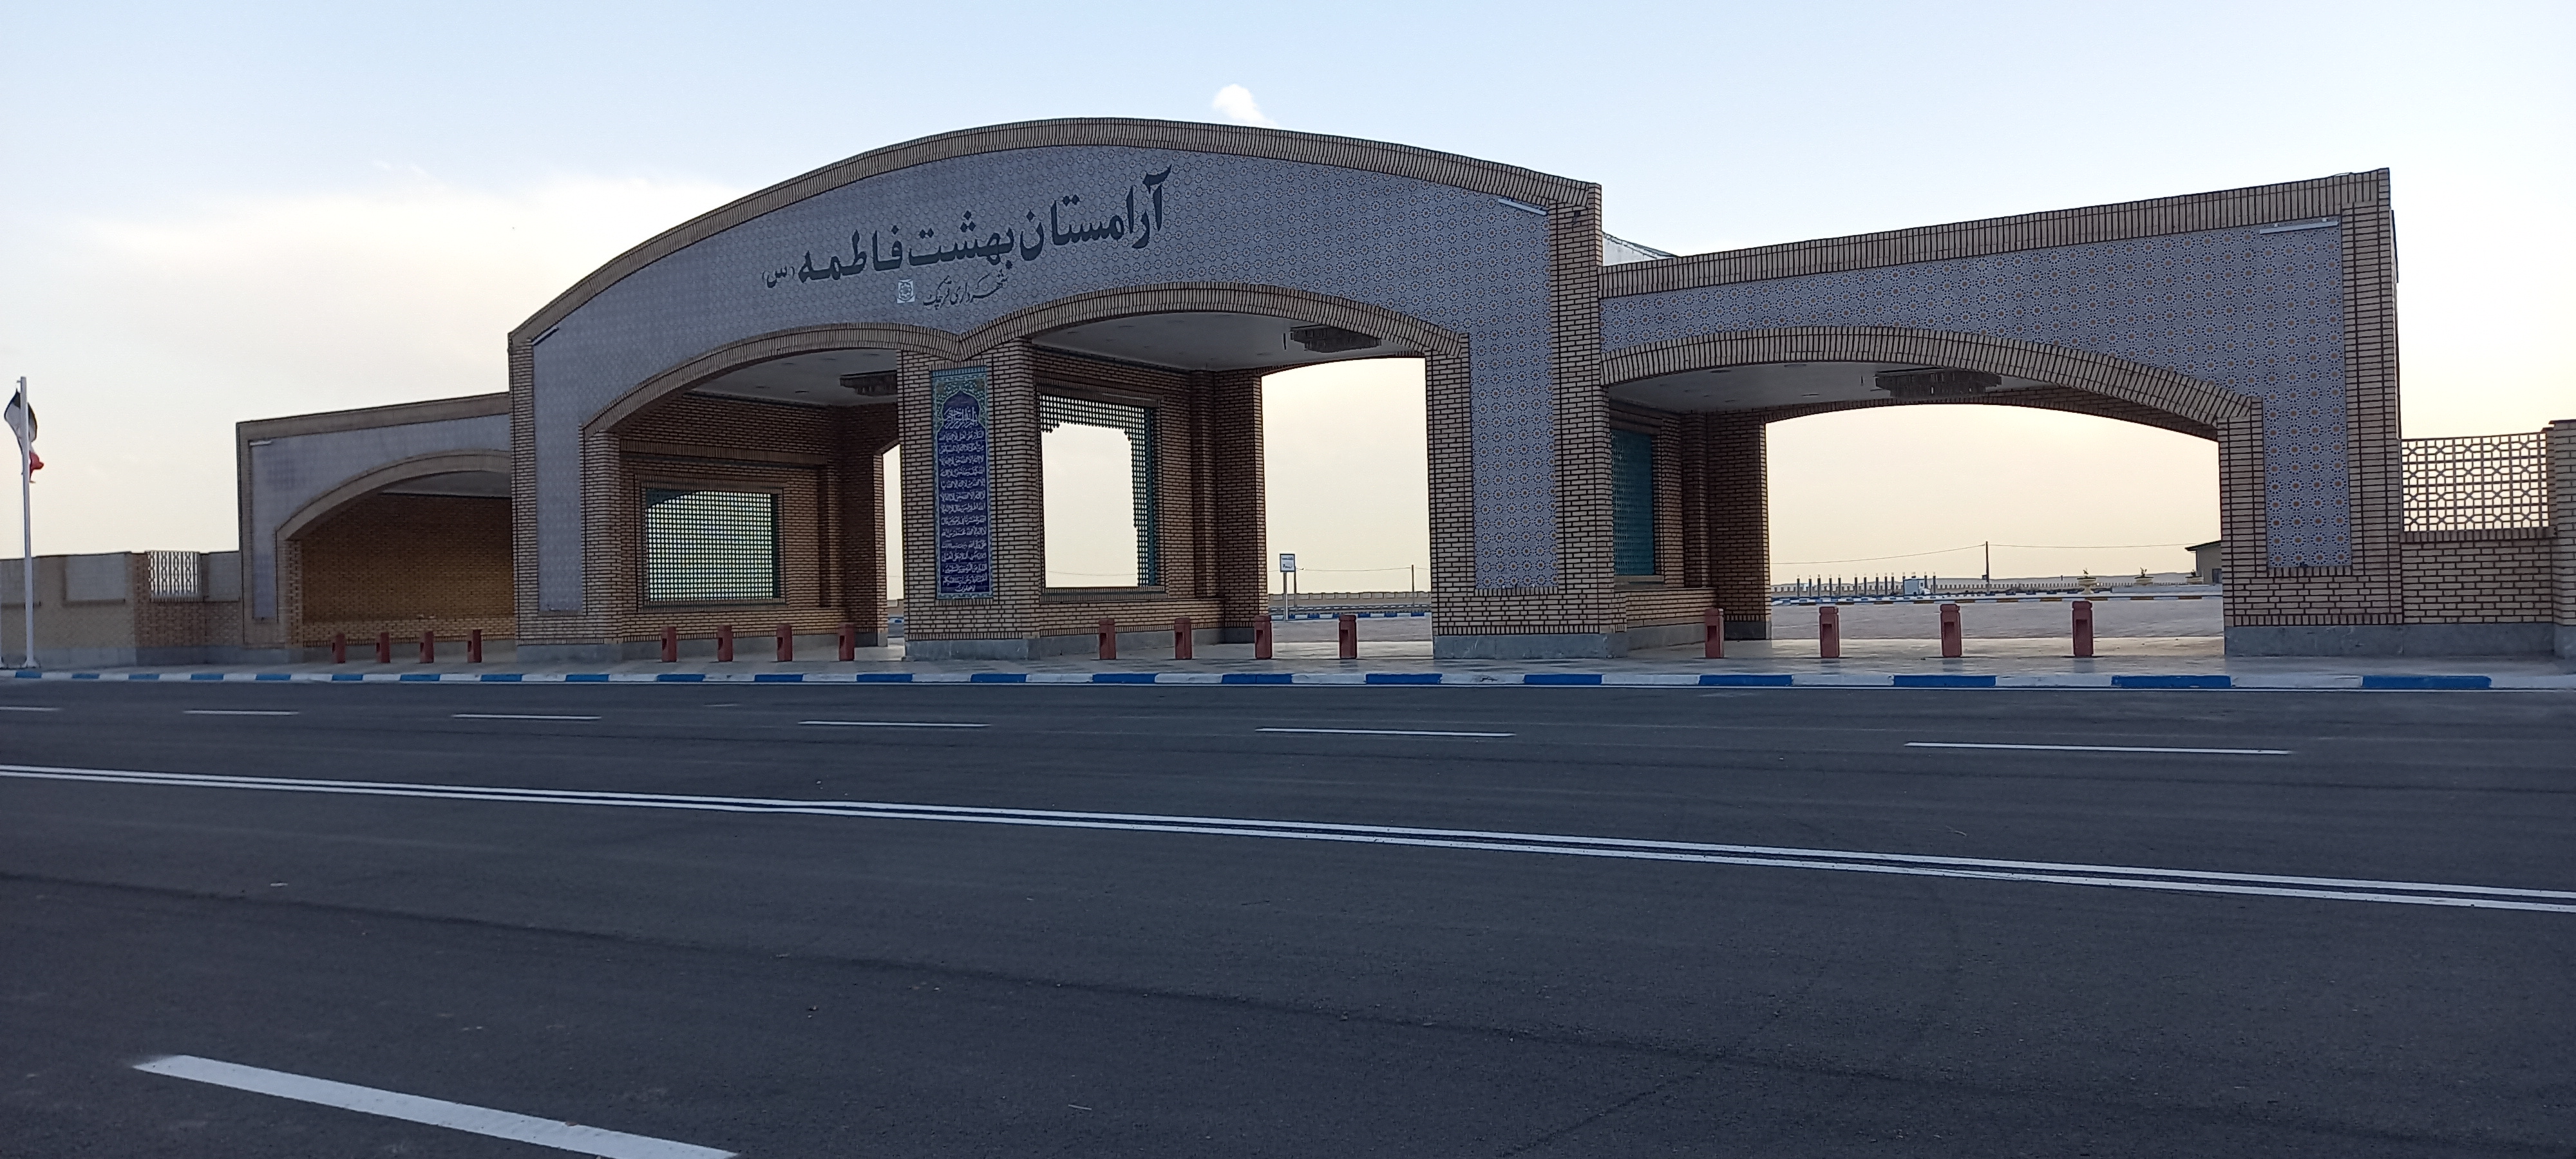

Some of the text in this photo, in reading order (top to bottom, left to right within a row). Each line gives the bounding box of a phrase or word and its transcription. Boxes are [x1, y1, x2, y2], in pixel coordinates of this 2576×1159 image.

[908, 210, 1014, 270] بهشت
[1019, 164, 1172, 261] آرامستان
[798, 225, 903, 283] فاطمه
[950, 269, 1009, 305] شهرداری
